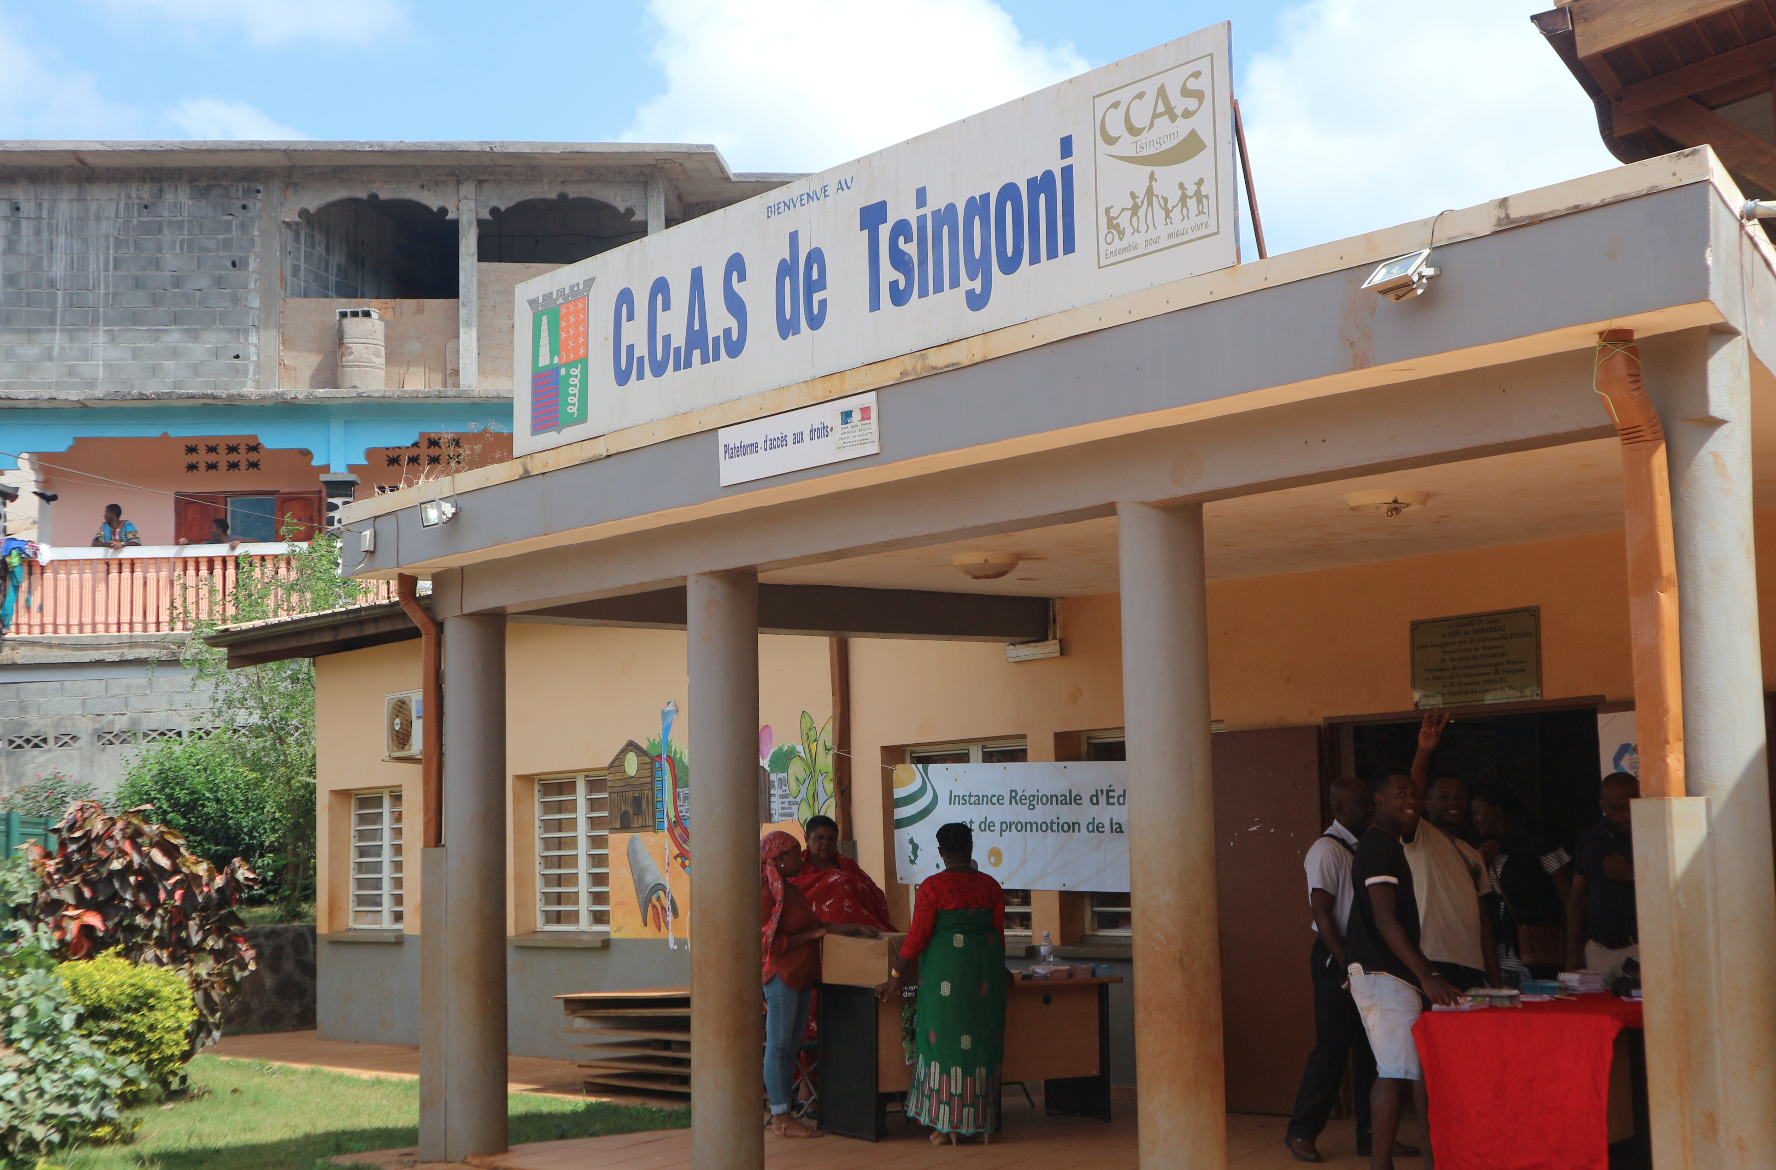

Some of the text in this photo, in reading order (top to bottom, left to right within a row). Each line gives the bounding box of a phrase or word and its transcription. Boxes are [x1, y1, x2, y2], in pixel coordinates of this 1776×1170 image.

[1100, 70, 1206, 146] CCAS
[1131, 125, 1180, 154] Tsingoni
[1104, 220, 1210, 260] Ensemble pour mieux vivre
[612, 134, 1076, 386] C.C.A.S de Tsingoni
[724, 440, 758, 460] Plateforme
[763, 432, 788, 452] d'accès
[792, 430, 804, 446] aux
[809, 422, 830, 442] droits
[948, 789, 1004, 806] Instance
[1009, 788, 1083, 810] Régionale
[978, 816, 996, 832] de
[1000, 816, 1081, 837] promotion
[1086, 816, 1106, 834] de
[1109, 816, 1124, 834] la
